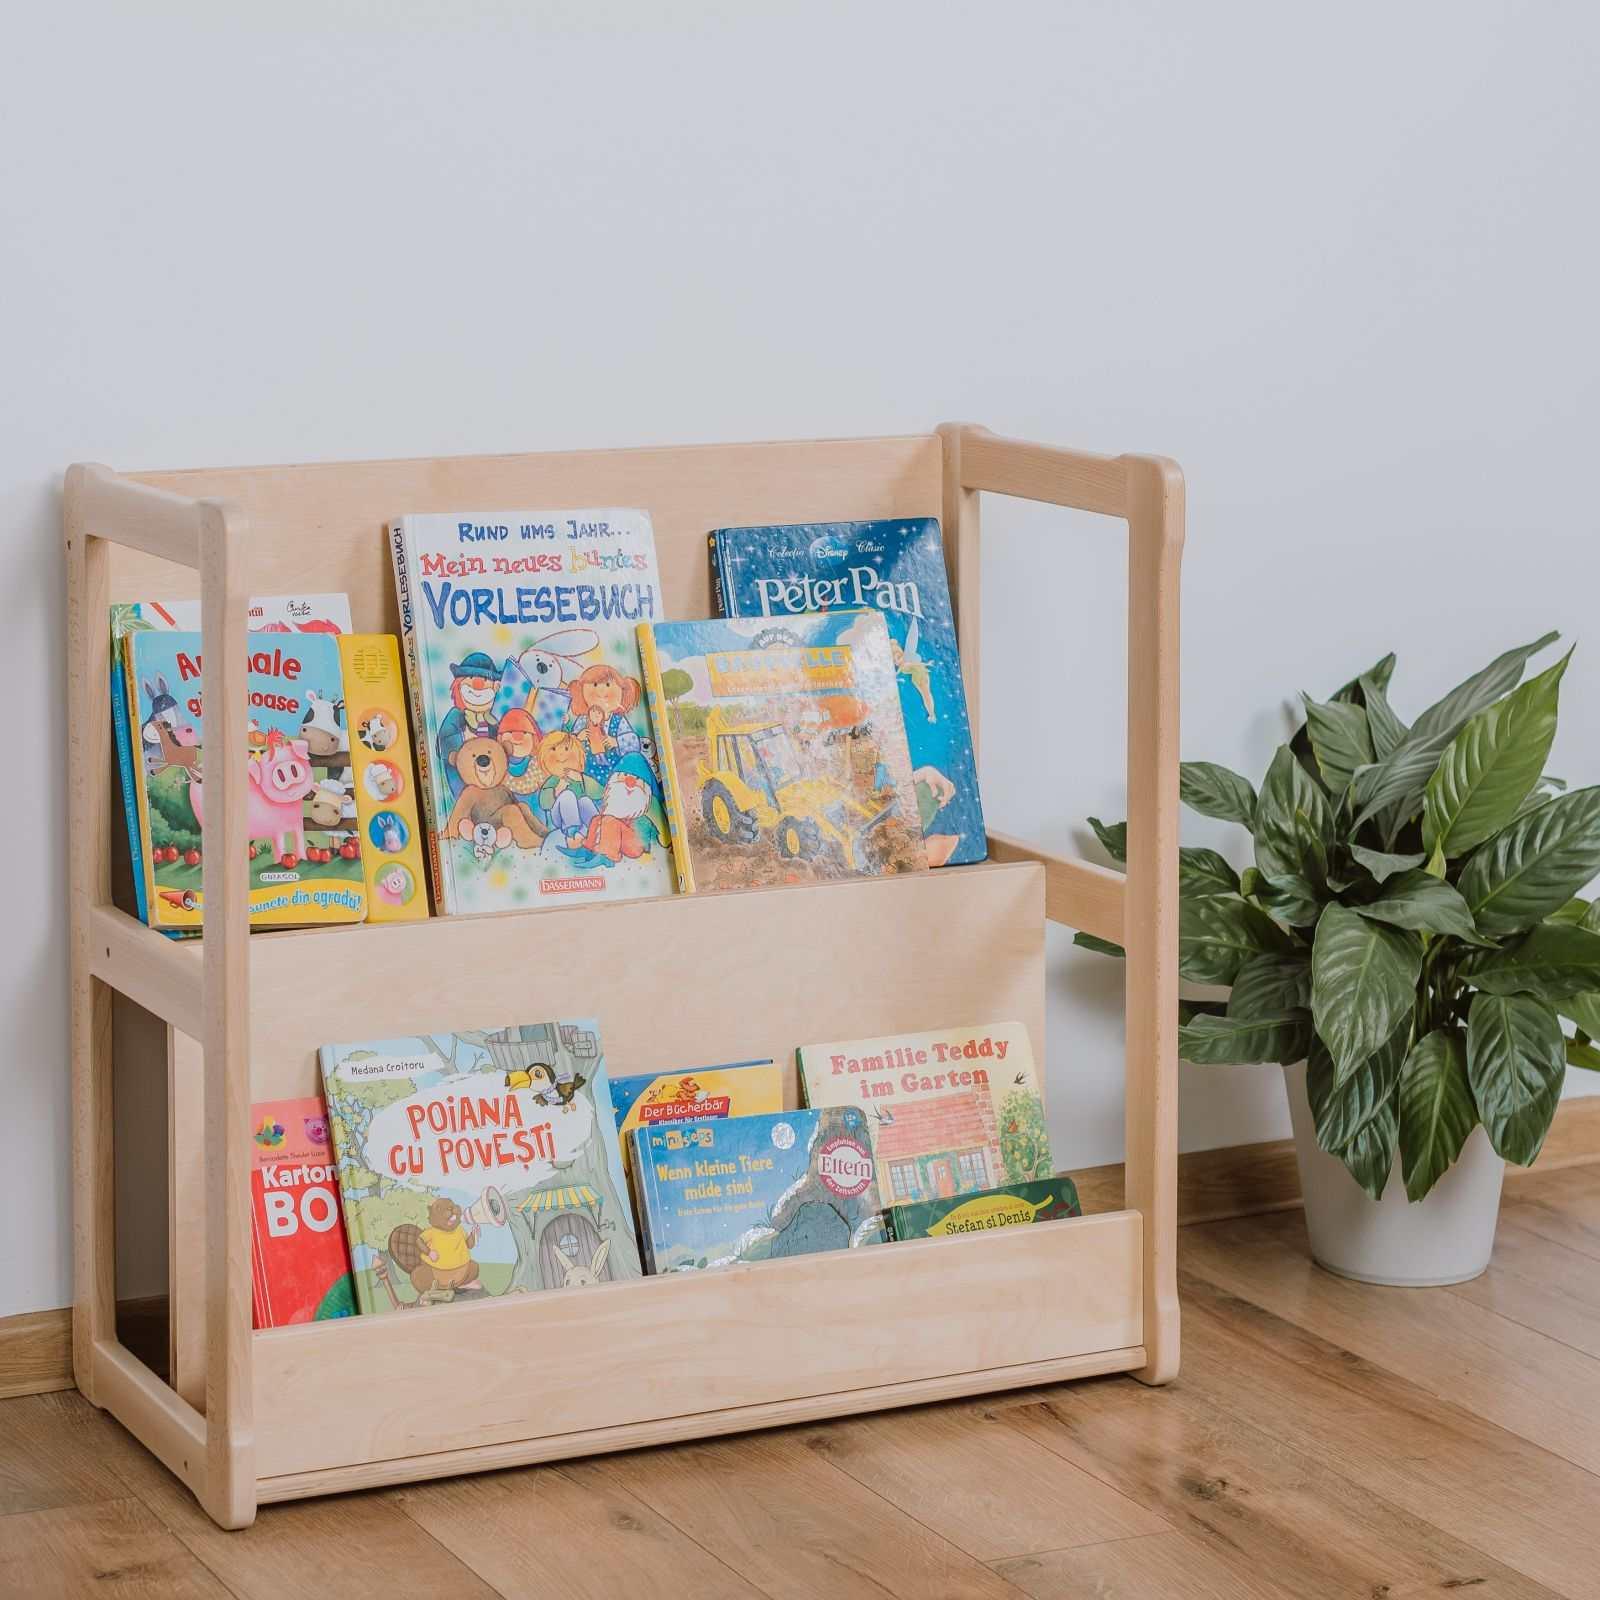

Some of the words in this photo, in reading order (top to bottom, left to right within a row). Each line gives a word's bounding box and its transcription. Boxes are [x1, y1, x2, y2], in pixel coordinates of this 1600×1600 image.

[458, 522, 508, 543] RUND
[520, 524, 555, 540] UMS
[420, 552, 486, 578] Mein
[493, 553, 563, 574] neues
[568, 545, 649, 573] buntes
[815, 545, 849, 560] Disney
[855, 539, 886, 553] Clasic
[393, 527, 413, 637] VORLESEBUCH
[754, 573, 849, 617] Peter
[848, 566, 928, 621] Pan
[420, 581, 654, 630] VORLESEBUCH
[176, 648, 302, 681] Aale
[291, 888, 310, 905] din
[351, 1065, 384, 1076] Medana
[386, 1061, 425, 1072] Croitoru
[830, 1047, 927, 1076] Familie
[932, 1037, 1009, 1063] Teddy
[860, 1078, 894, 1100] im
[900, 1068, 989, 1093] Garten
[644, 1106, 665, 1118] Der
[666, 1099, 724, 1116] Bücherbär
[387, 1143, 425, 1177] CU
[656, 1164, 692, 1182] Wenn
[695, 1159, 737, 1177] kleine
[738, 1154, 774, 1173] Tiere
[822, 1156, 872, 1178] Eltern
[684, 1179, 721, 1201] müde
[726, 1175, 753, 1196] sind
[263, 1187, 338, 1238] BO
[945, 1218, 985, 1236] Stefan
[998, 1210, 1032, 1227] Denis
